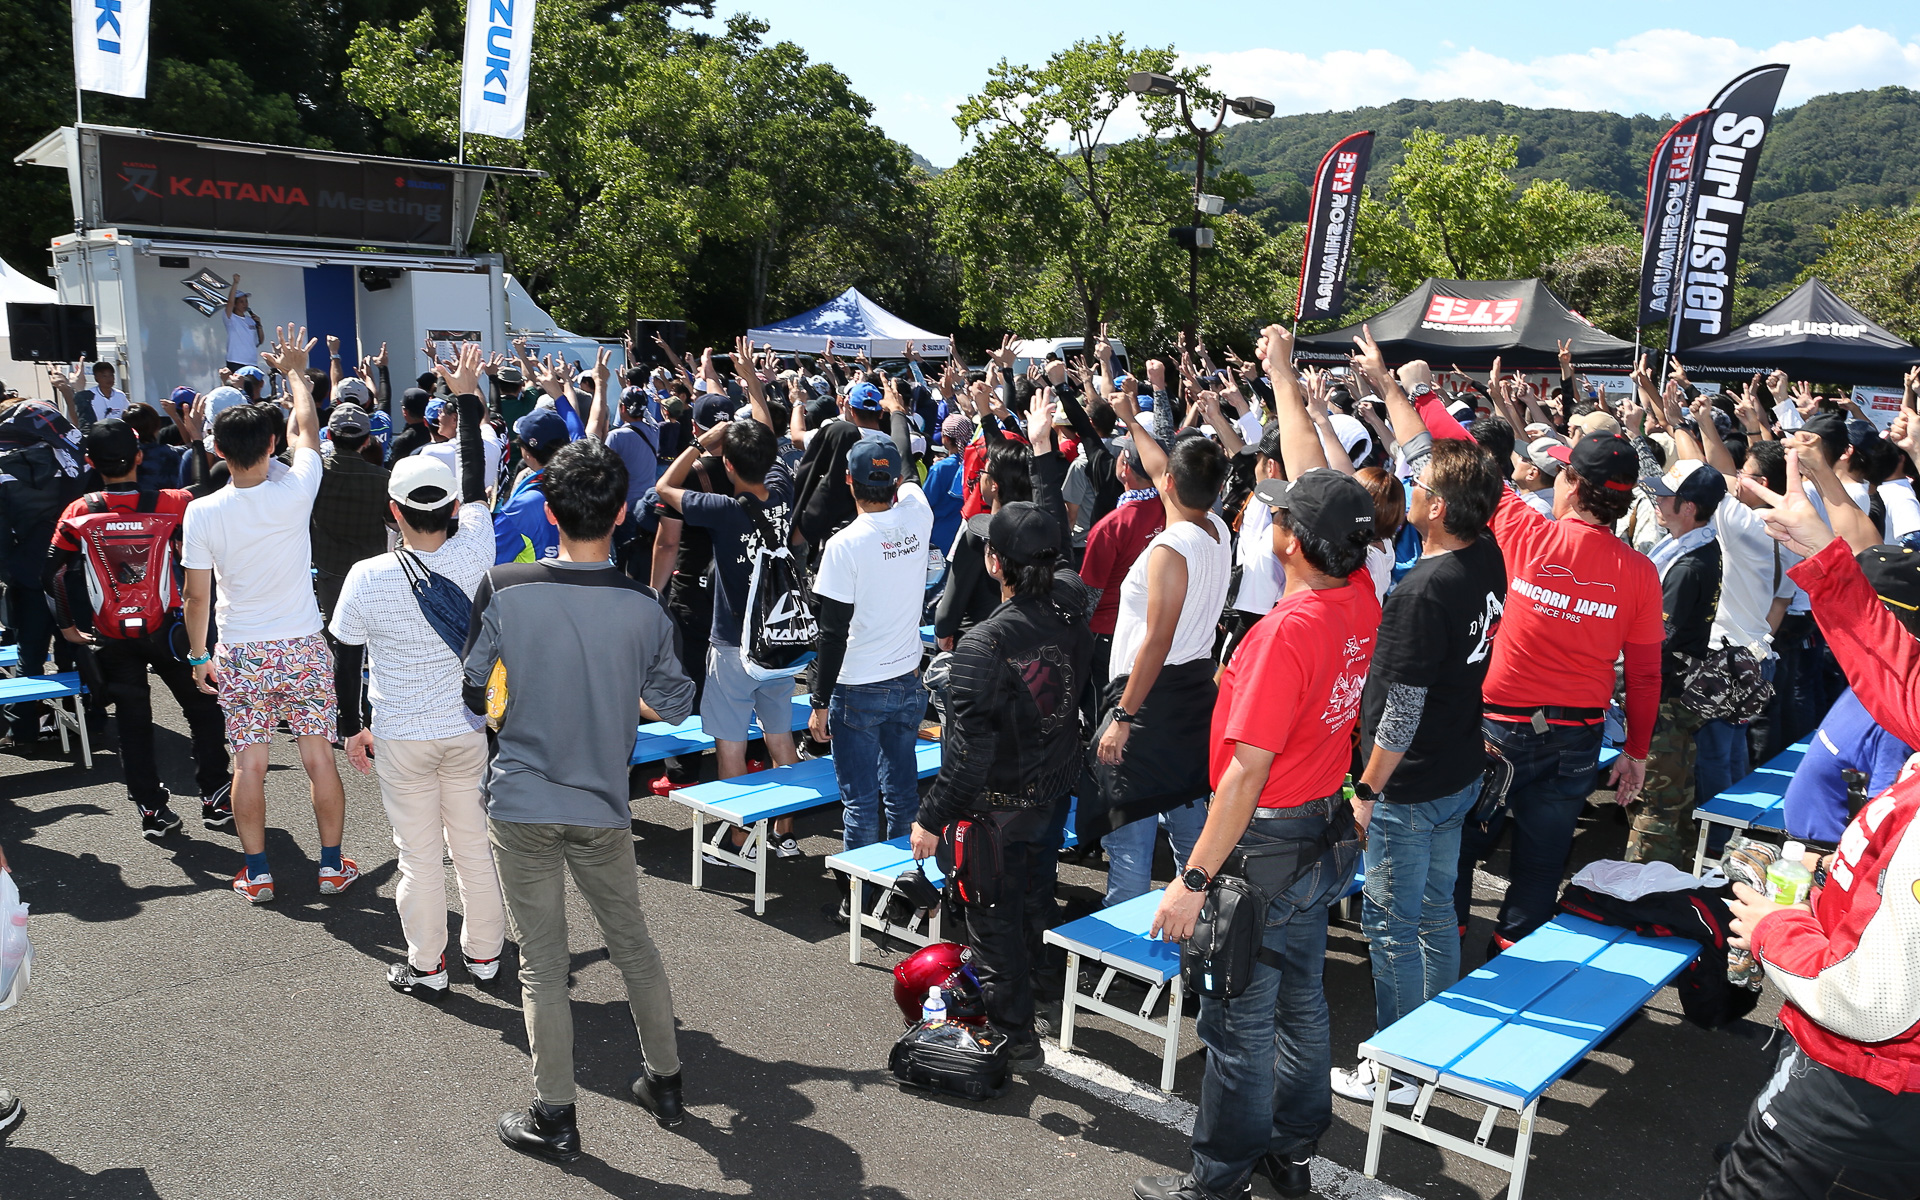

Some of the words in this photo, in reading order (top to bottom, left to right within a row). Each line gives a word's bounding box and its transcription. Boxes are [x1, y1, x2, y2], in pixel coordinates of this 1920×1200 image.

[122, 161, 157, 169] KATANA
[407, 179, 446, 191] SUZUKI
[169, 176, 310, 206] KATANA
[318, 190, 443, 222] Meeting
[1684, 112, 1765, 335] SurLuster
[1428, 297, 1520, 325] ヨシムラ
[1420, 321, 1513, 332] YOSHIMURA
[1748, 320, 1868, 338] SurLuster
[836, 342, 867, 351] SUZUKI
[105, 522, 144, 531] MOTUL
[904, 534, 918, 546] Got
[883, 550, 897, 560] The
[1510, 577, 1571, 610] UNICORN
[1573, 598, 1618, 619] JAPAN
[1533, 603, 1560, 618] SINCE
[1561, 611, 1581, 623] 1985
